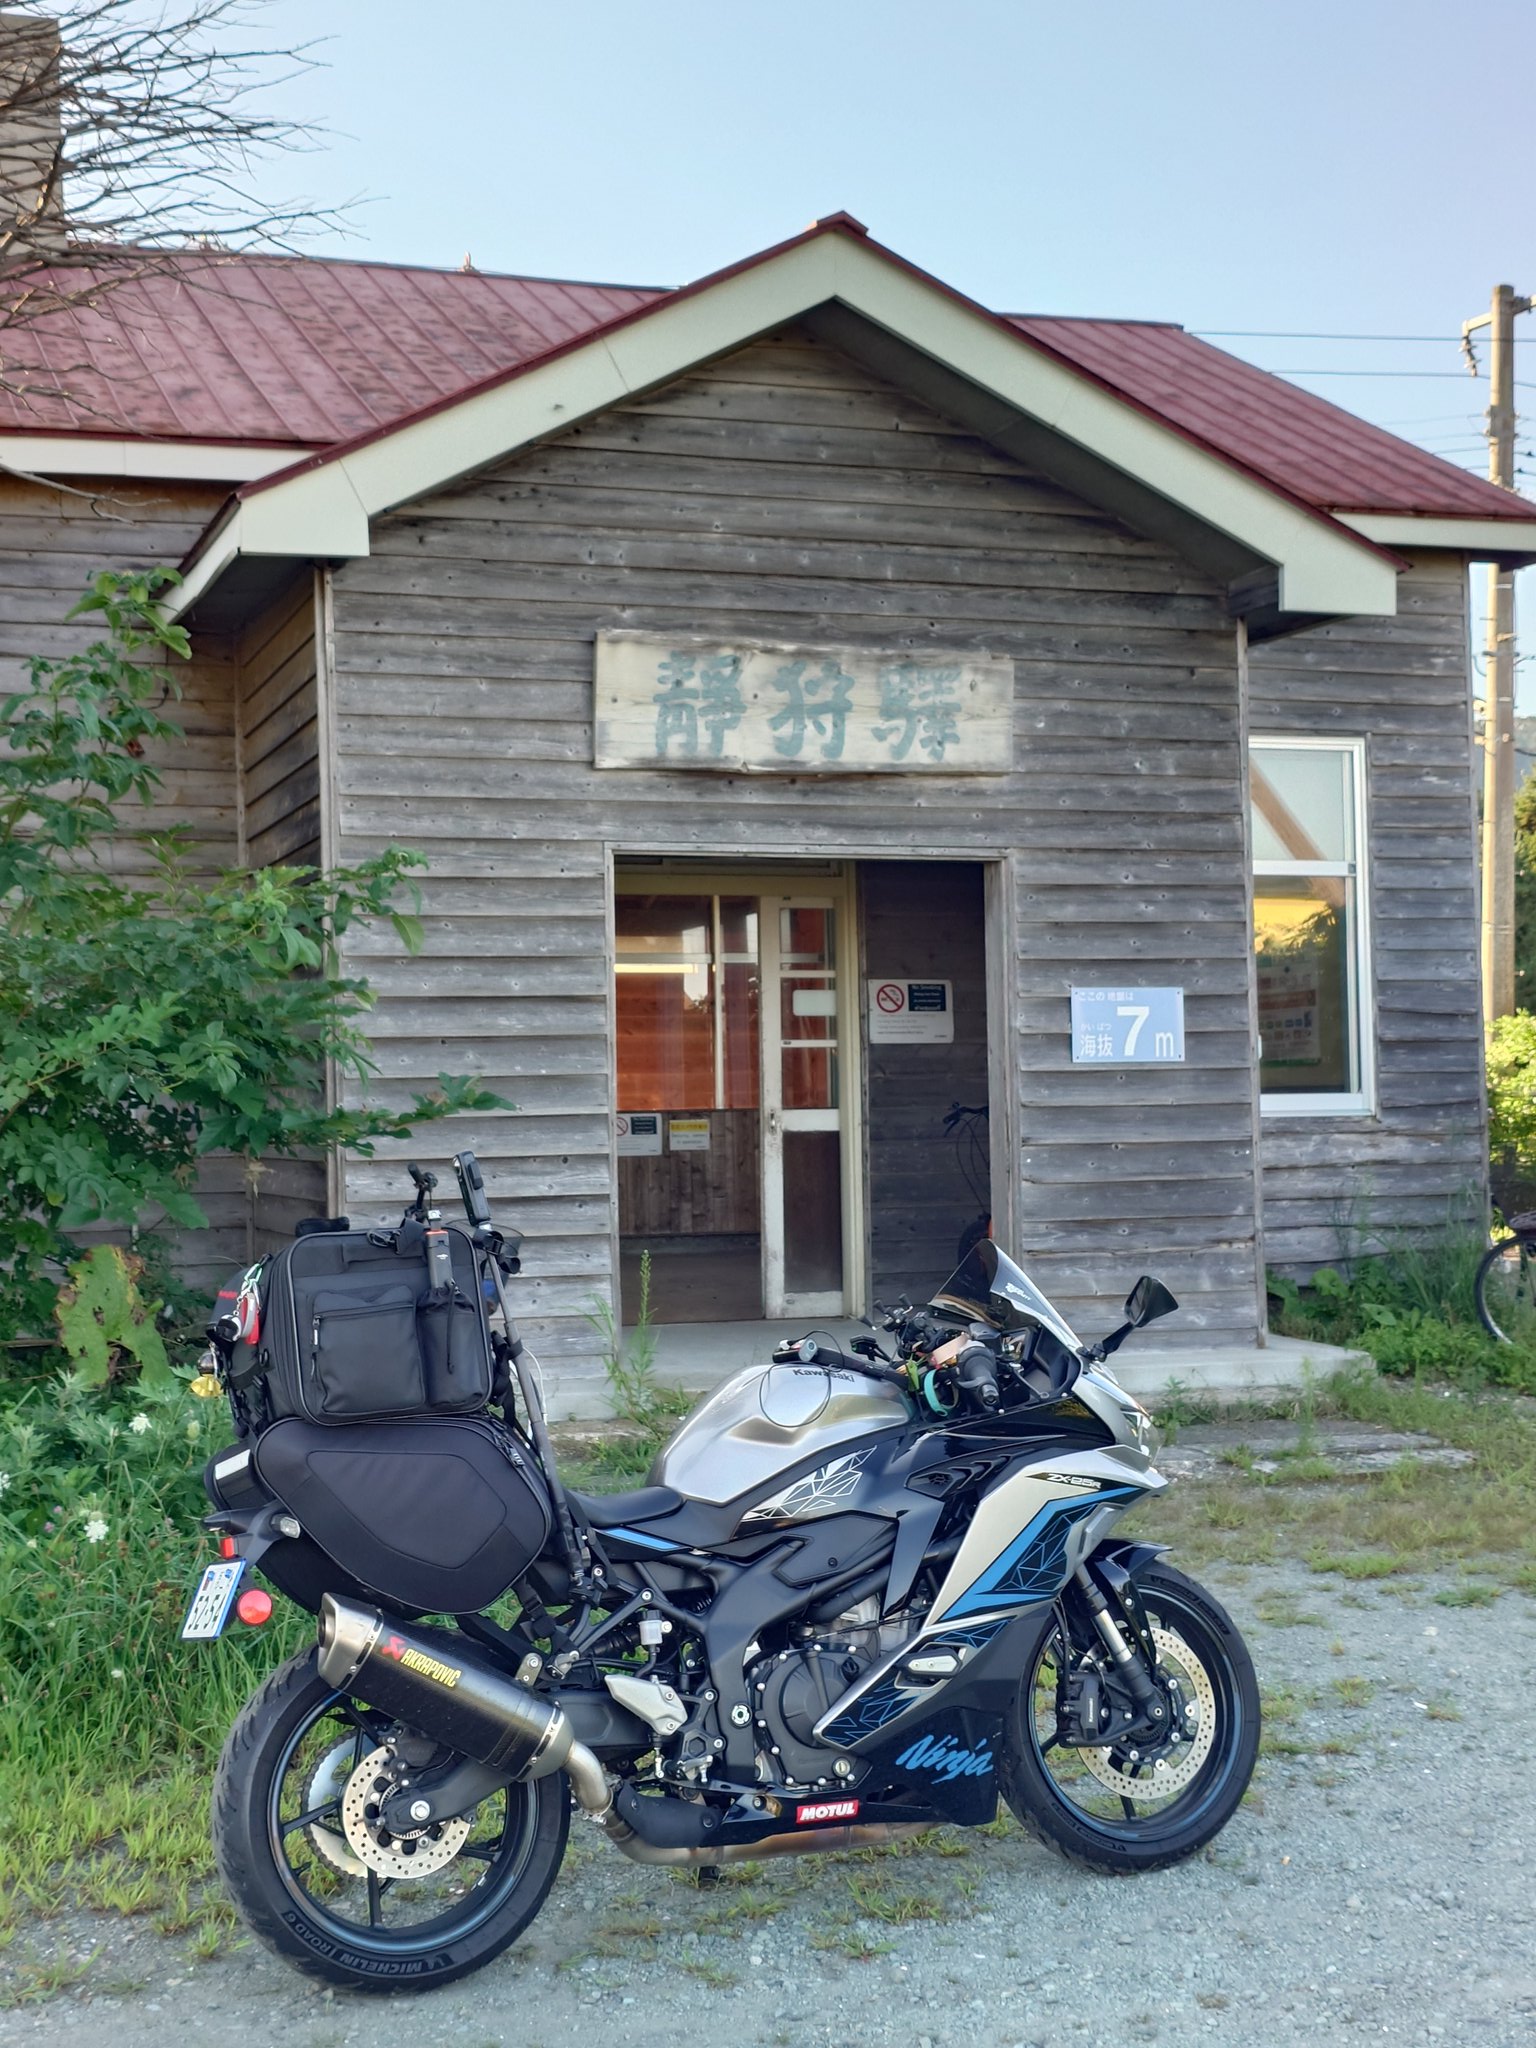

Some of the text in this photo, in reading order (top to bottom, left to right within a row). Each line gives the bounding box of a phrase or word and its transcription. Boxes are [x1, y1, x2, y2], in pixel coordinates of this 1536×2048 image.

[1080, 1006, 1174, 1057] 海抜 7 m
[793, 1369, 855, 1383] Kawasaki
[1047, 1472, 1102, 1489] ZX-25R
[895, 1735, 994, 1785] Ninja
[799, 1803, 855, 1821] MOTUL
[295, 1923, 331, 1953] ROAD
[338, 1953, 422, 1974] MICHELIN
